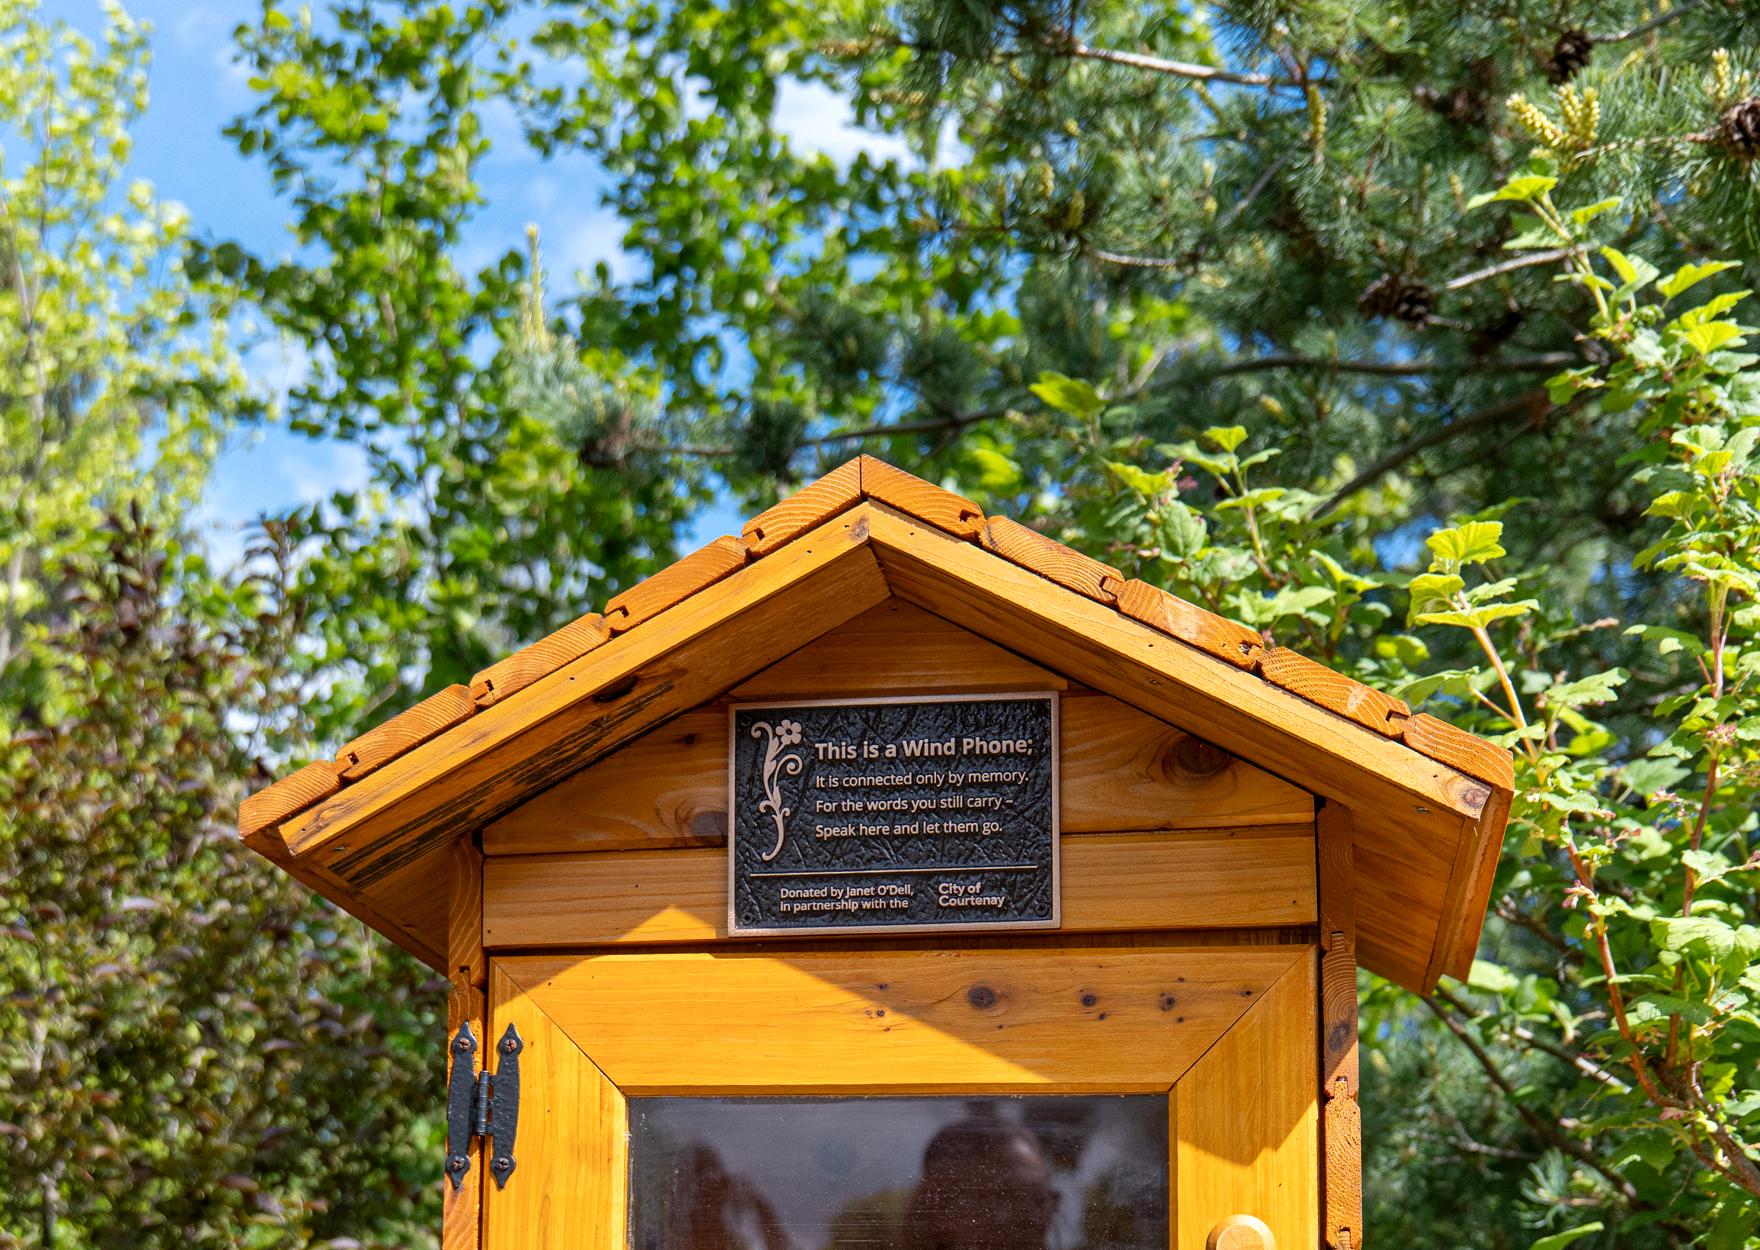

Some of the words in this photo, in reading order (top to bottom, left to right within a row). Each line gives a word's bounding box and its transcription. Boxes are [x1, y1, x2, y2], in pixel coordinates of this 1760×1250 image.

[815, 742, 857, 760] This
[863, 741, 879, 758] is
[885, 743, 897, 757] a
[902, 737, 956, 757] Wind
[962, 737, 1033, 755] Phone;
[816, 776, 825, 788] It
[829, 775, 839, 787] is
[843, 772, 912, 787] connected
[916, 771, 945, 787] only
[948, 771, 965, 786] by
[968, 771, 1029, 784] memory.
[816, 800, 838, 813] For
[841, 799, 863, 812] the
[867, 797, 908, 811] words
[911, 799, 937, 813] you
[940, 795, 963, 809] still
[967, 796, 1003, 810] carry
[816, 824, 856, 840] Speak
[860, 823, 890, 836] here
[893, 821, 919, 835] and
[923, 821, 941, 833] let
[943, 820, 979, 833] them
[982, 821, 1003, 835] go.
[780, 887, 828, 899] Donated
[830, 886, 844, 899] by
[845, 886, 875, 899] Janet
[938, 882, 965, 896] City
[967, 881, 982, 894] of
[793, 898, 859, 913] partnership
[862, 898, 886, 909] with
[889, 897, 909, 909] the
[938, 895, 1005, 907] Courtenay
